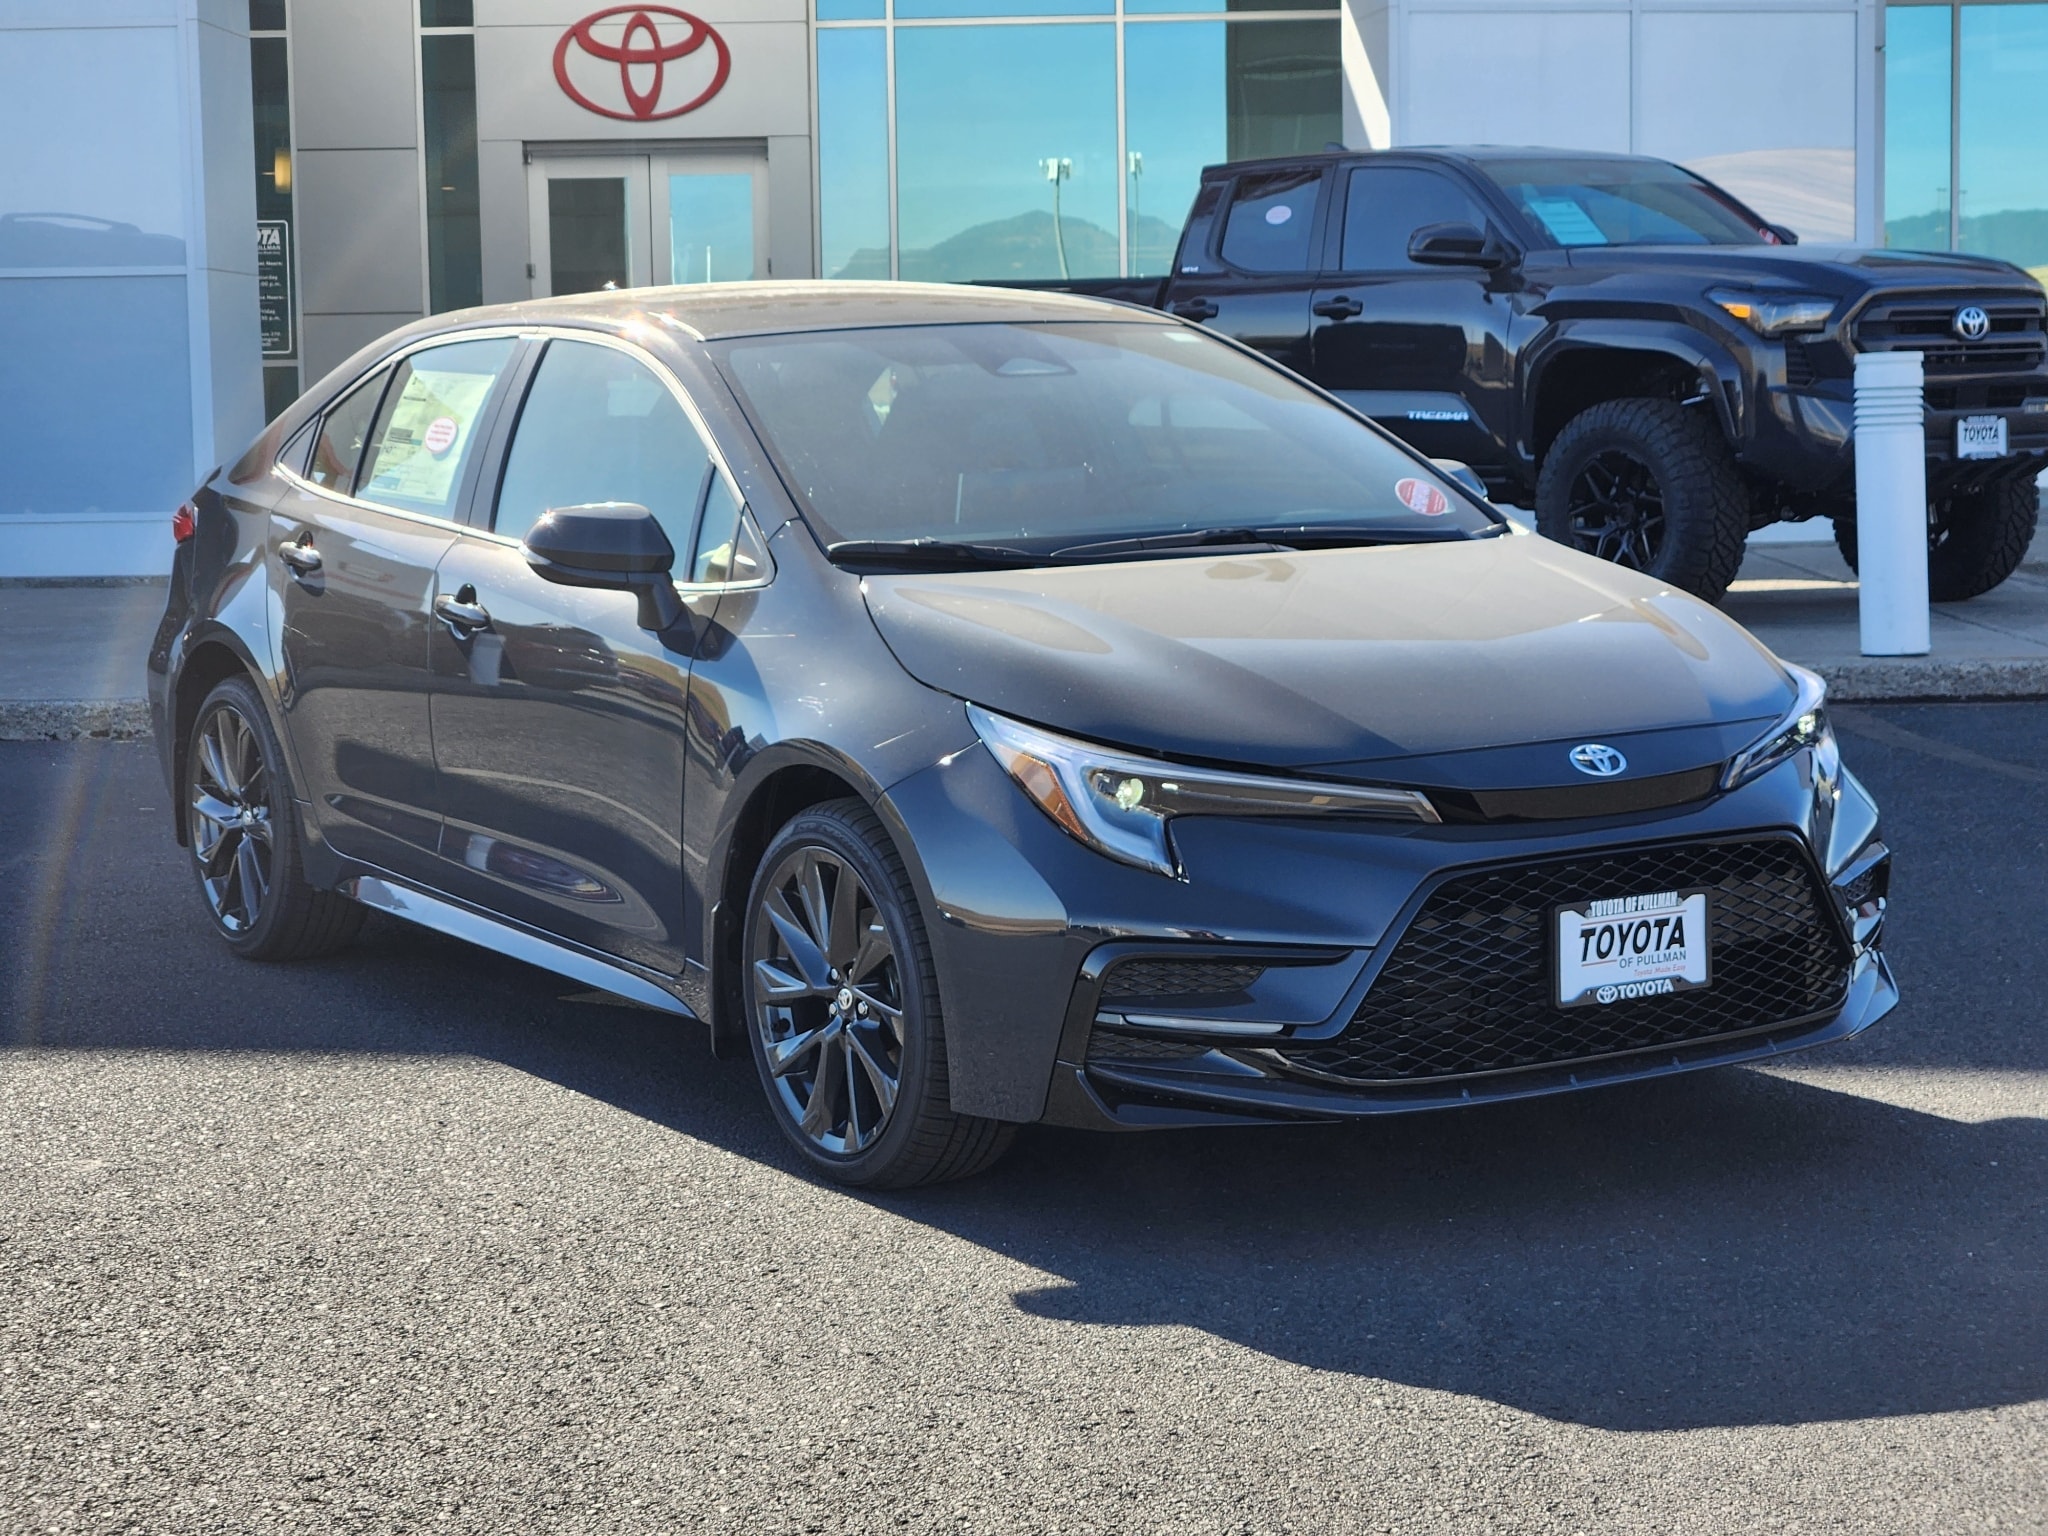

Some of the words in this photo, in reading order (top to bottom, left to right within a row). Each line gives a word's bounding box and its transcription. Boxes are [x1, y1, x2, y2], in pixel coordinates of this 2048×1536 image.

[1407, 410, 1469, 421] TACOMA
[1964, 426, 1999, 441] TOYOTA
[1590, 899, 1624, 917] TOYOTA
[1625, 896, 1638, 912] OF
[1638, 891, 1678, 911] PULLMAN
[1580, 916, 1685, 962] TOYOTA
[1619, 957, 1634, 969] OF
[1636, 951, 1687, 966] PULLMAN
[1654, 966, 1671, 974] Made
[1672, 964, 1686, 972] Easy
[1617, 978, 1674, 999] TOYOTA
